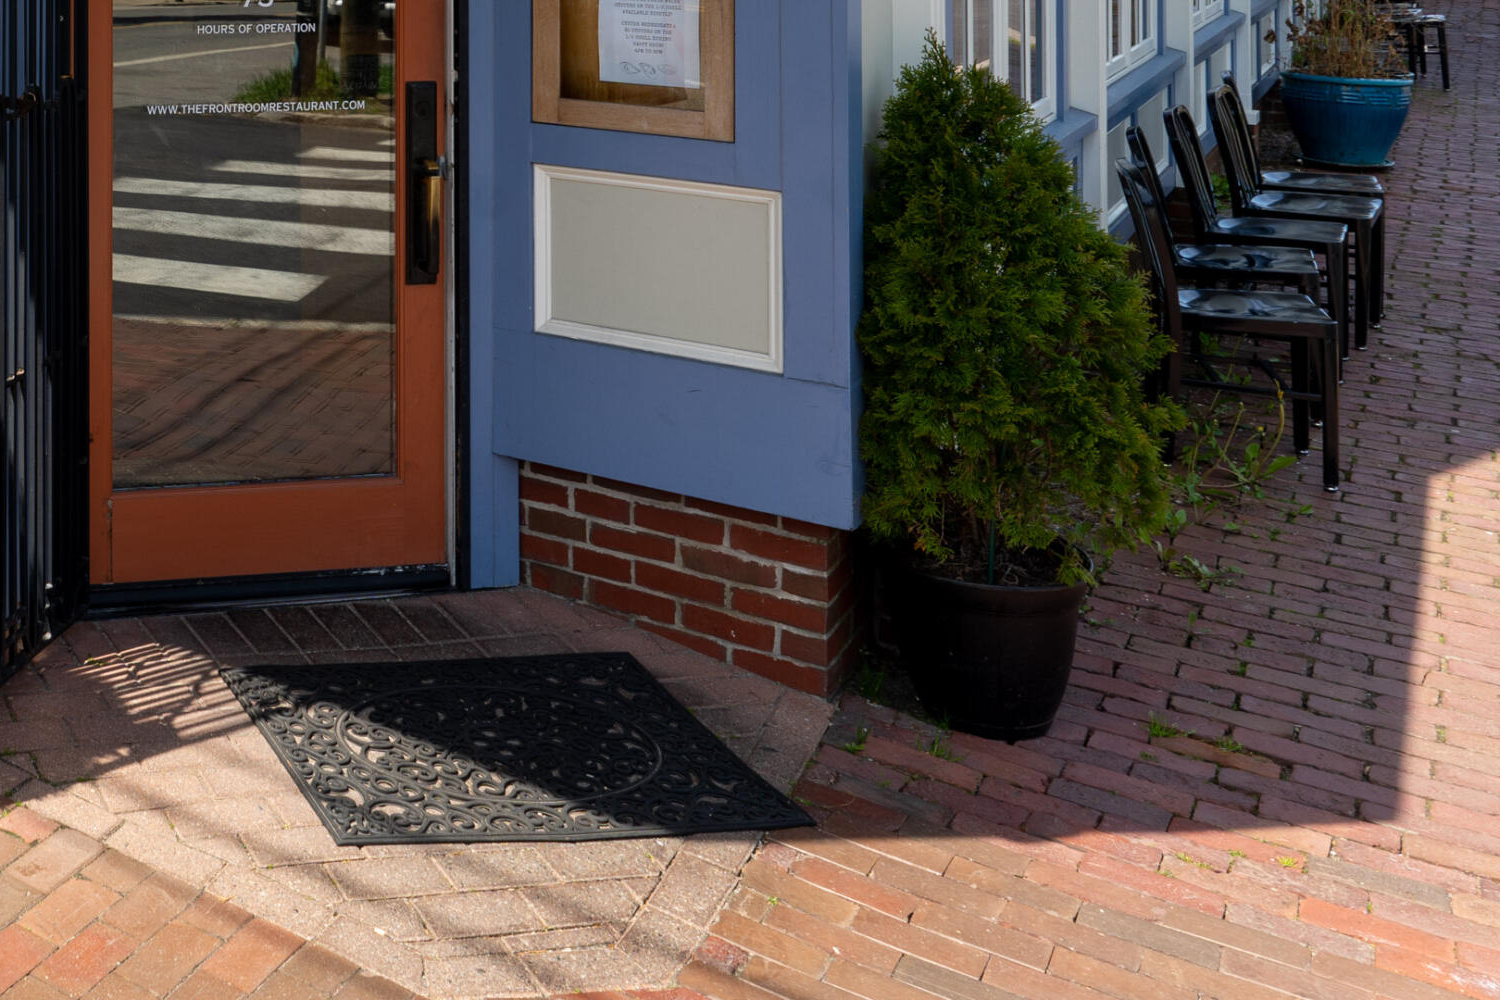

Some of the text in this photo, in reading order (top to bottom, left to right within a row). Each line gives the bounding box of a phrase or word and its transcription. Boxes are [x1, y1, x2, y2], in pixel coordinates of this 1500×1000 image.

[197, 22, 316, 34] HOURS OF OPERATION
[147, 100, 366, 116] WWW.THEFRONTROOMRESTAURANT.COM
